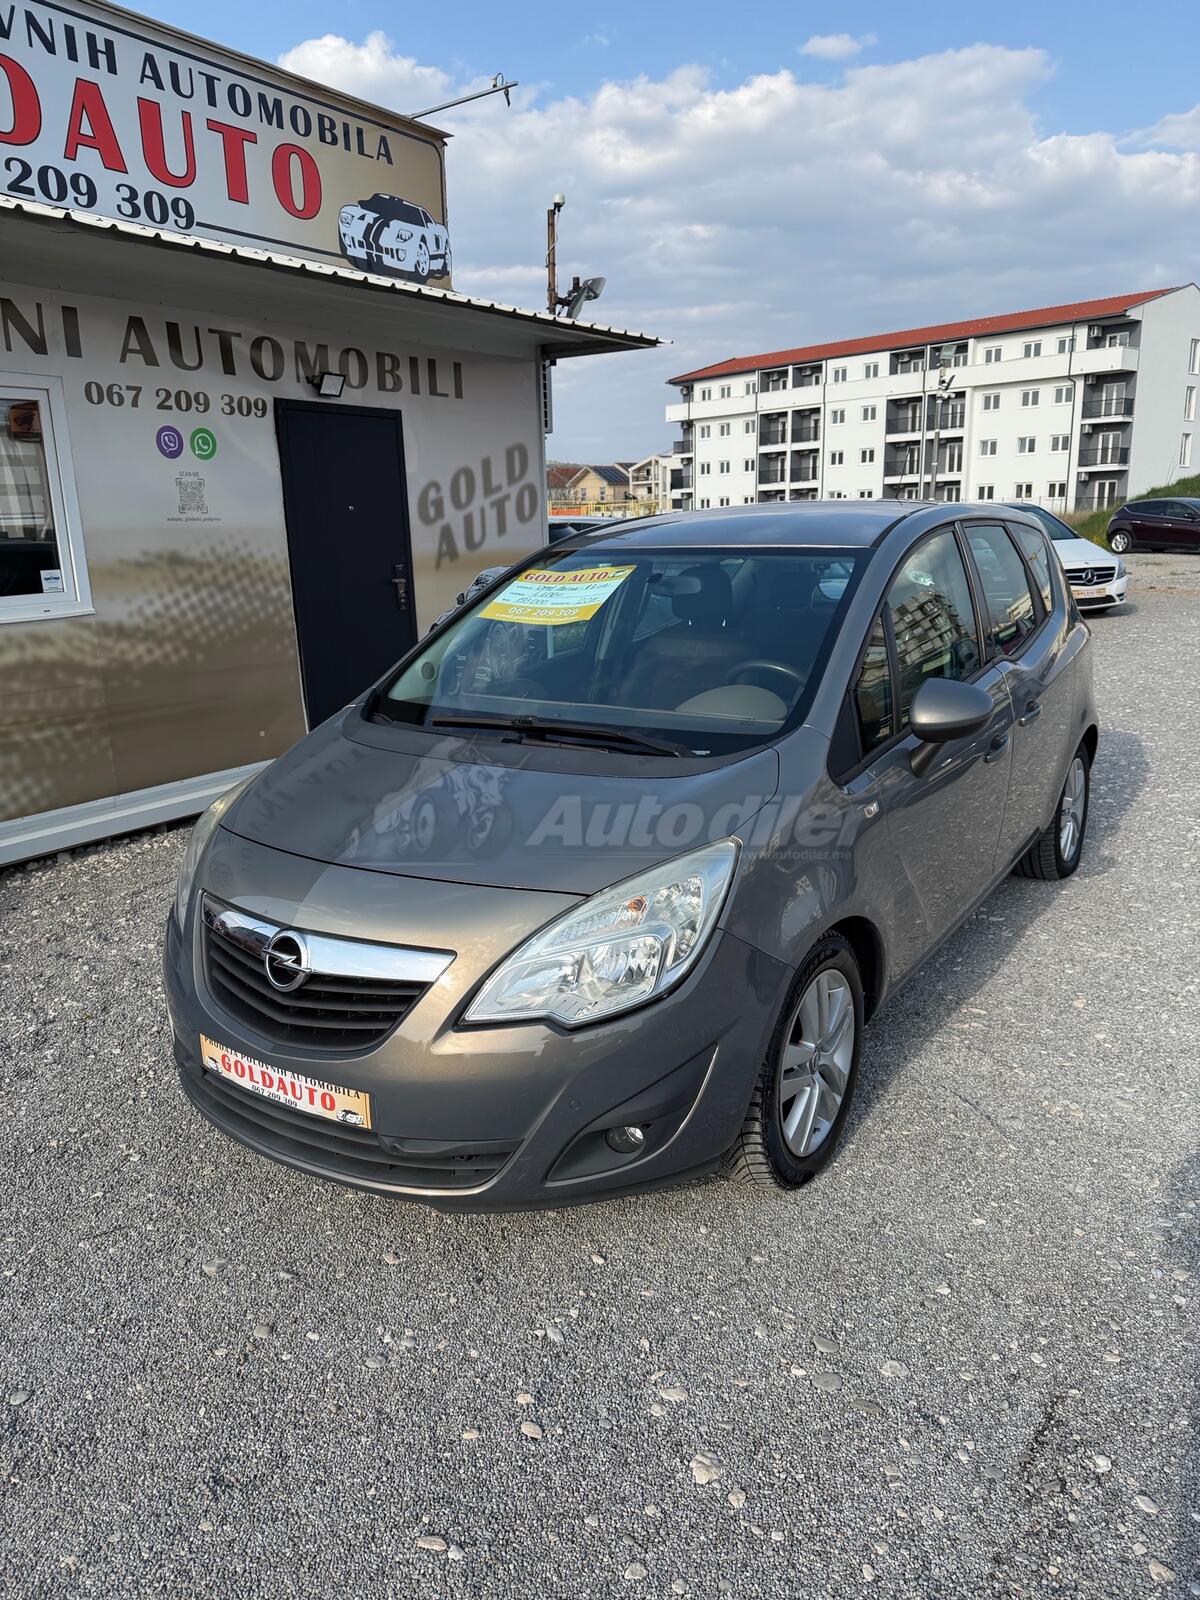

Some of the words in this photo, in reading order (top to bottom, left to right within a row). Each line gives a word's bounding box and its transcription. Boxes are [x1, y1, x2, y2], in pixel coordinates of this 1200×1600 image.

[139, 52, 394, 166] AUTOMOBILA
[4, 157, 98, 209] 209
[115, 183, 196, 230] 309
[0, 297, 83, 358] NI
[119, 315, 463, 399] AUTOMOBILI
[84, 380, 143, 408] 067
[155, 387, 211, 413] 209
[220, 393, 268, 418] 309
[418, 443, 529, 525] GOLD
[435, 483, 539, 571] AUTO
[524, 572, 565, 582] GOLD
[569, 571, 609, 582] AUTO
[508, 606, 532, 615] 067
[532, 608, 556, 616] 209
[556, 608, 580, 617] 309
[221, 1053, 336, 1112] GOLDAUTO
[251, 1084, 265, 1095] 067
[267, 1091, 281, 1101] 209
[283, 1097, 298, 1108] 309
[290, 1072, 361, 1100] AUTOMOBILA
